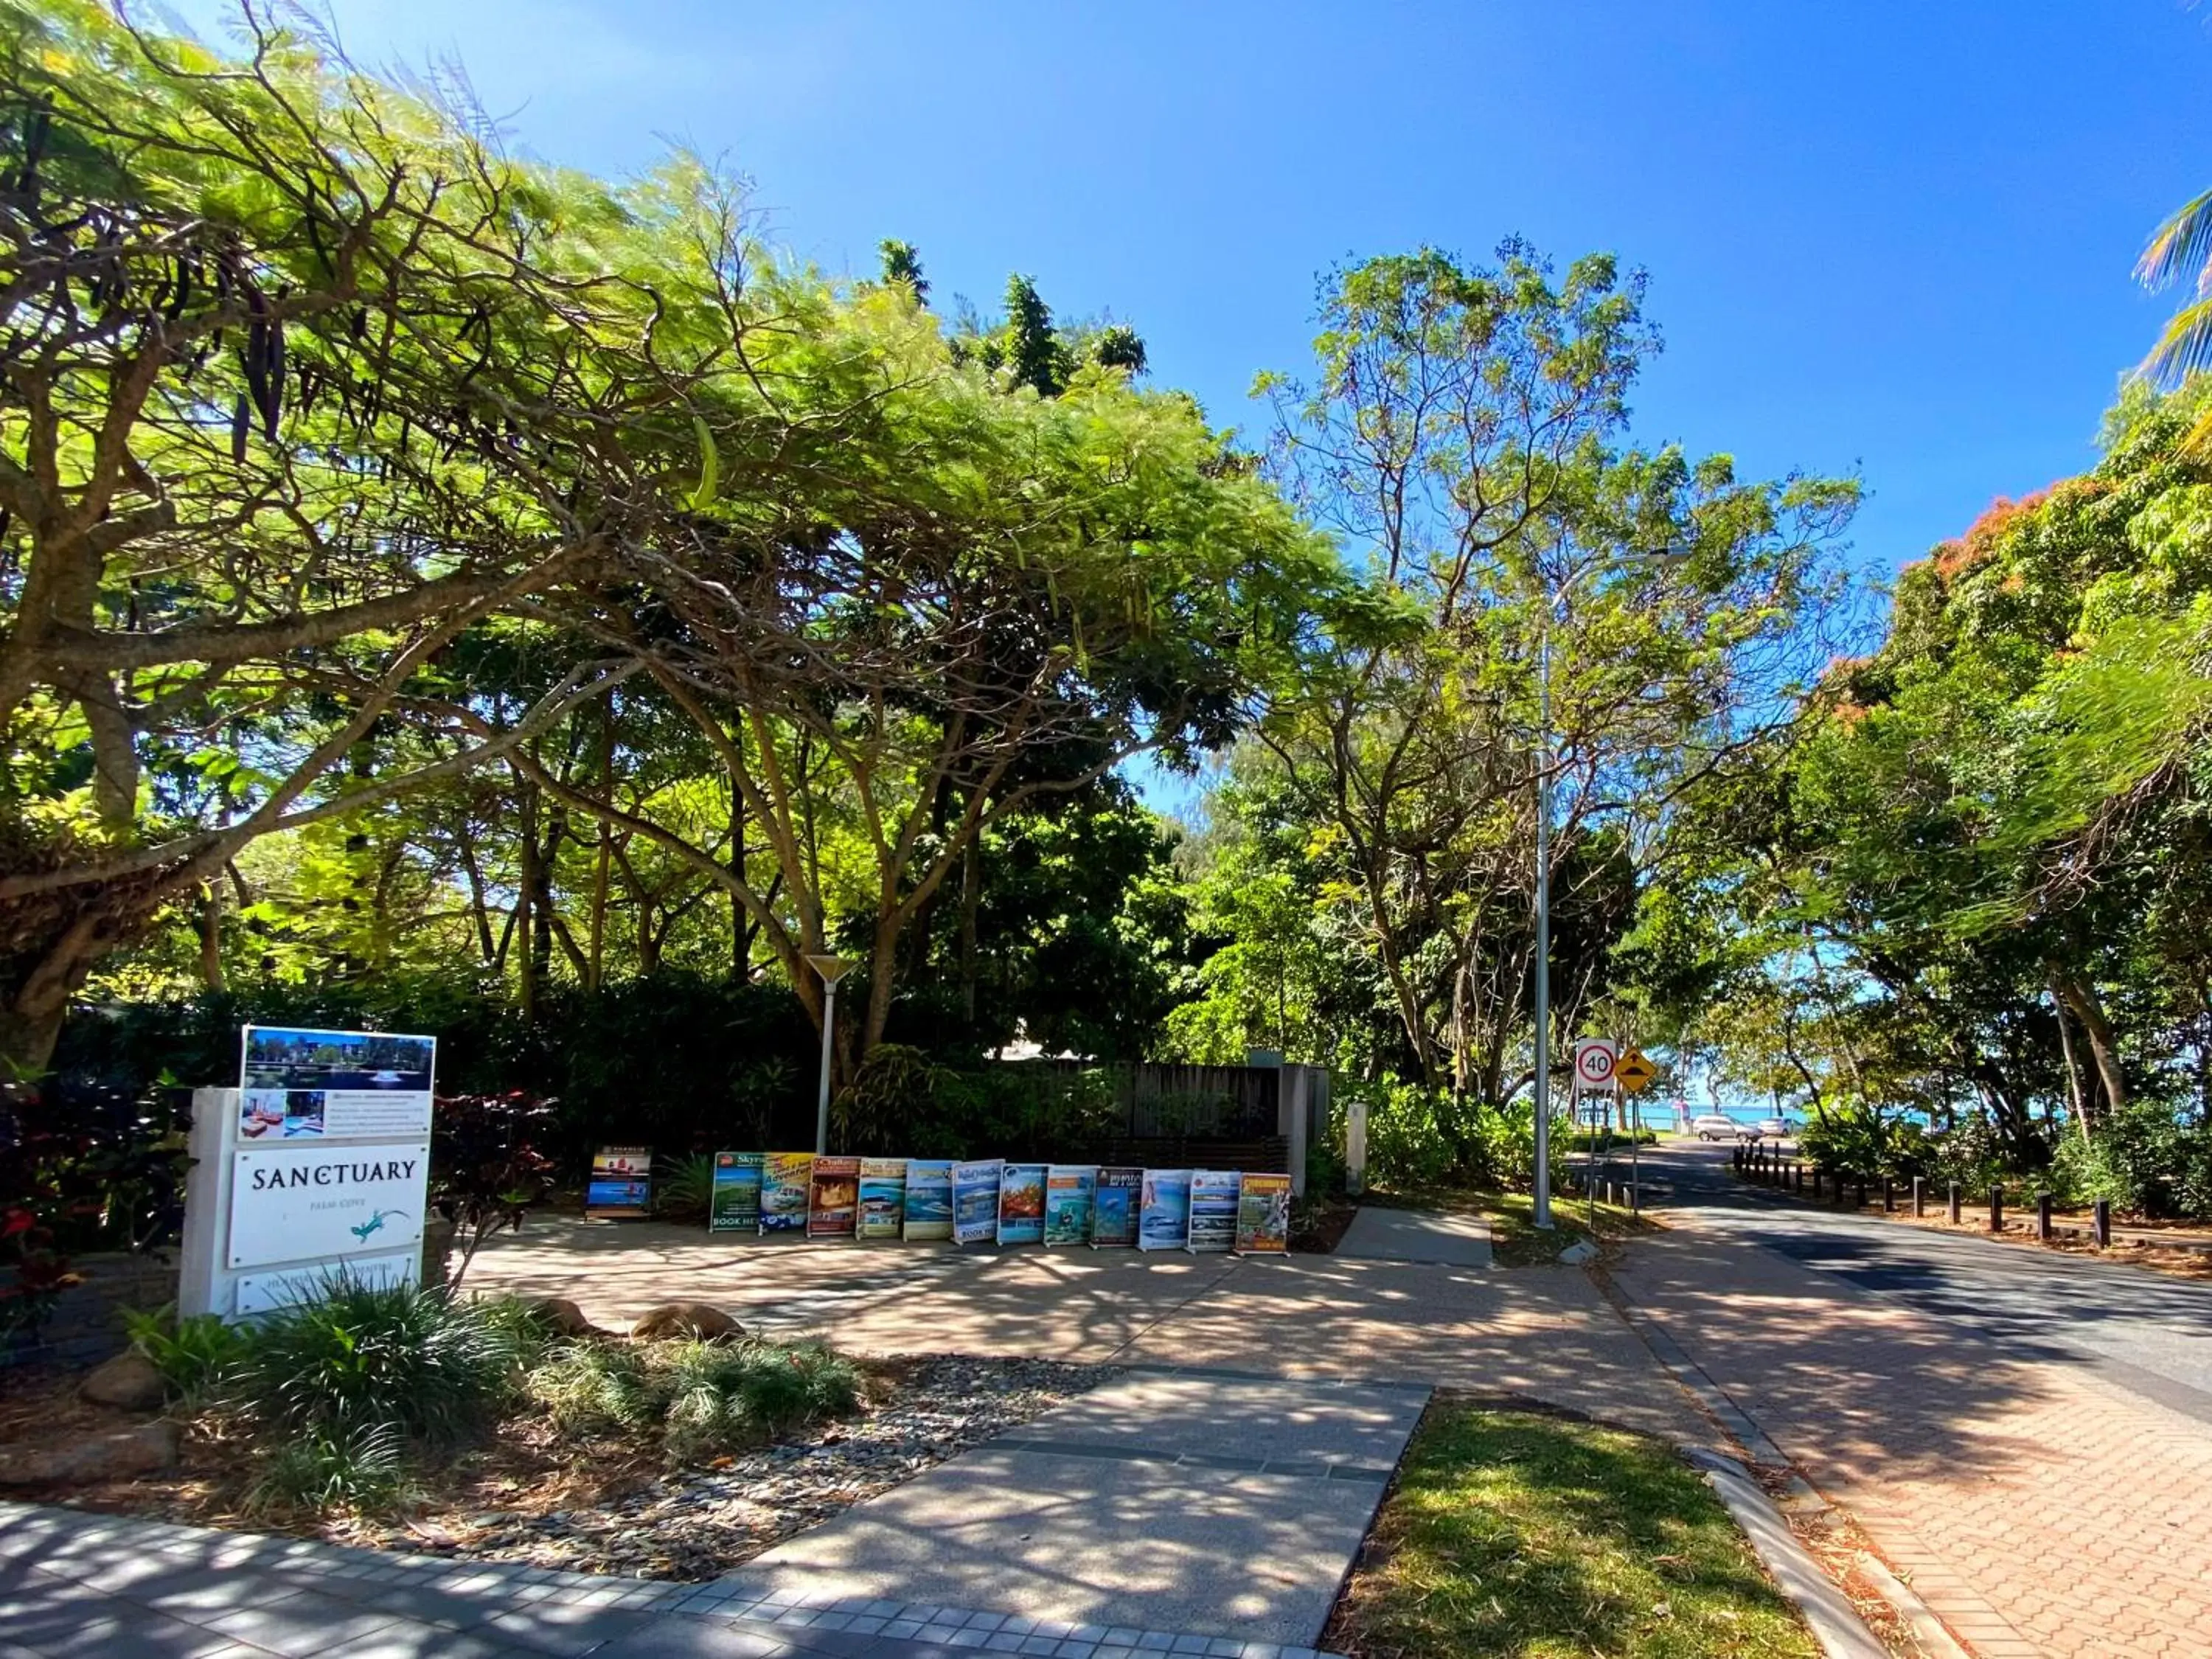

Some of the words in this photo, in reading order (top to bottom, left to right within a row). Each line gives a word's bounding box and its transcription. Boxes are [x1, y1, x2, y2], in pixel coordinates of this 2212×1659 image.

[1585, 1056, 1608, 1072] 40
[252, 1160, 417, 1190] SANCTUARY
[310, 1200, 337, 1211] PALM
[339, 1198, 366, 1208] COVE
[713, 1217, 741, 1225] BOOK
